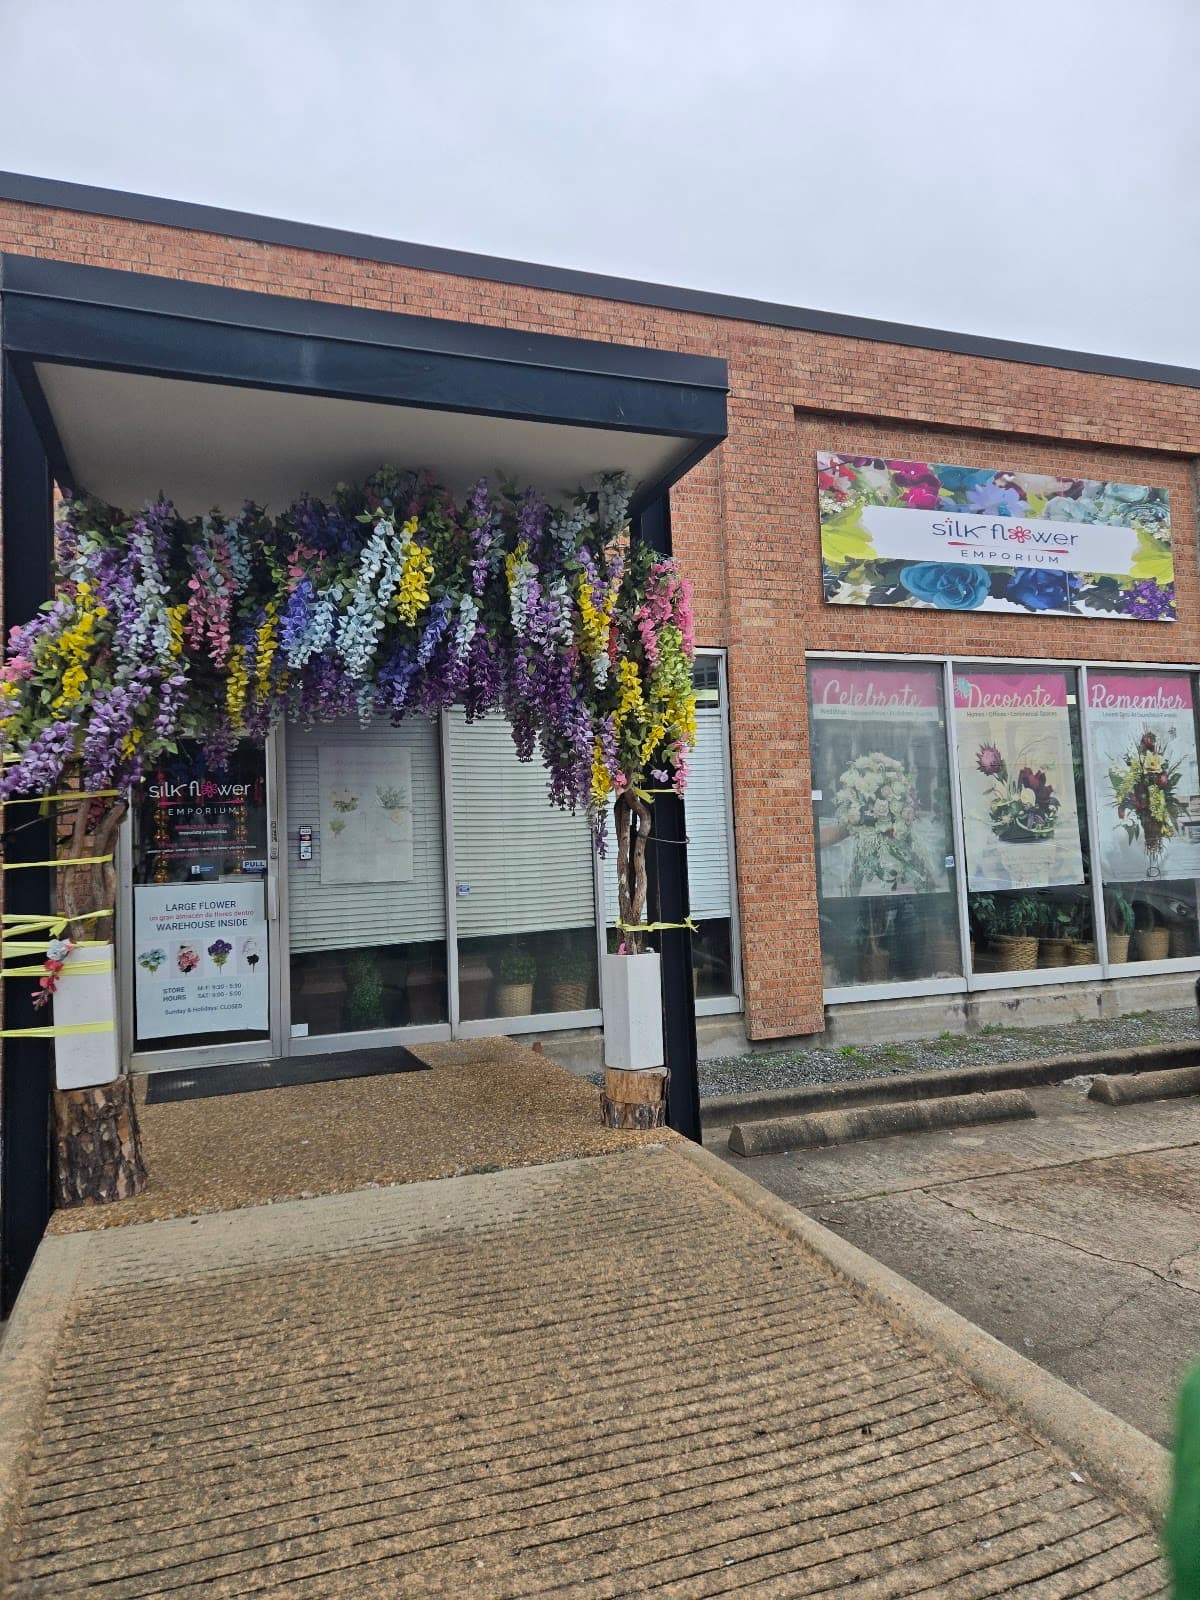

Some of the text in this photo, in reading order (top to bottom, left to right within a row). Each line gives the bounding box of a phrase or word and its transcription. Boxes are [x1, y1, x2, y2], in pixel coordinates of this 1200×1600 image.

[931, 517, 987, 538] silk
[960, 549, 1060, 564] EMPORIUM
[822, 679, 922, 707] Celebrate
[966, 683, 1056, 708] Decorate
[1091, 684, 1187, 709] Remember
[148, 781, 187, 798] silk
[167, 807, 236, 816] EMPORIUM
[165, 900, 237, 912] LARGE FLOWER
[156, 918, 248, 932] WAREHOUSE INSIDE
